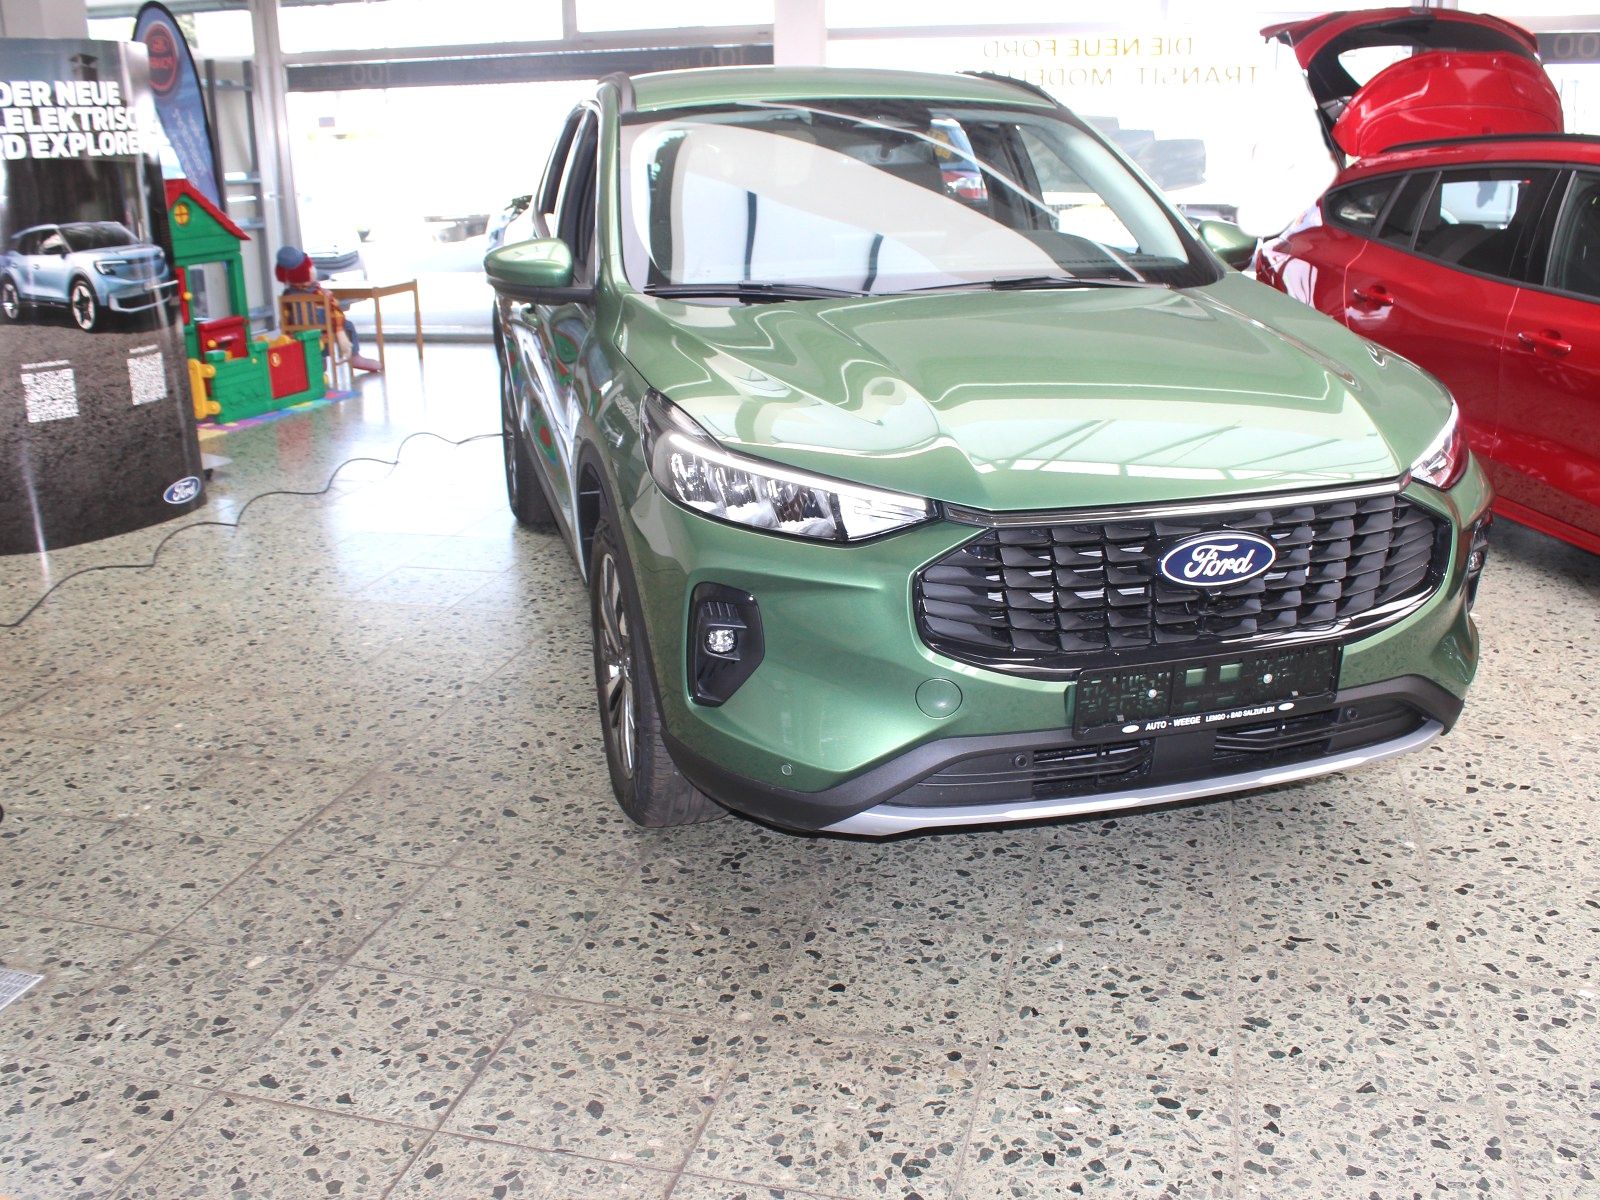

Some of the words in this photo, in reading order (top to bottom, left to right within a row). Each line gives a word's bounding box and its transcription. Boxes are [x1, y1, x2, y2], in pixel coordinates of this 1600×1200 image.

[0, 81, 52, 107] DER
[55, 81, 121, 106] NEUE
[29, 131, 148, 159] EXPLORE
[1184, 544, 1255, 578] Ford
[1144, 720, 1167, 731] AUTO
[1173, 716, 1201, 728] WEEGE
[1205, 713, 1226, 723] LEMGO
[1230, 710, 1243, 719] BAD
[1243, 706, 1275, 717] SALZUFLEN
